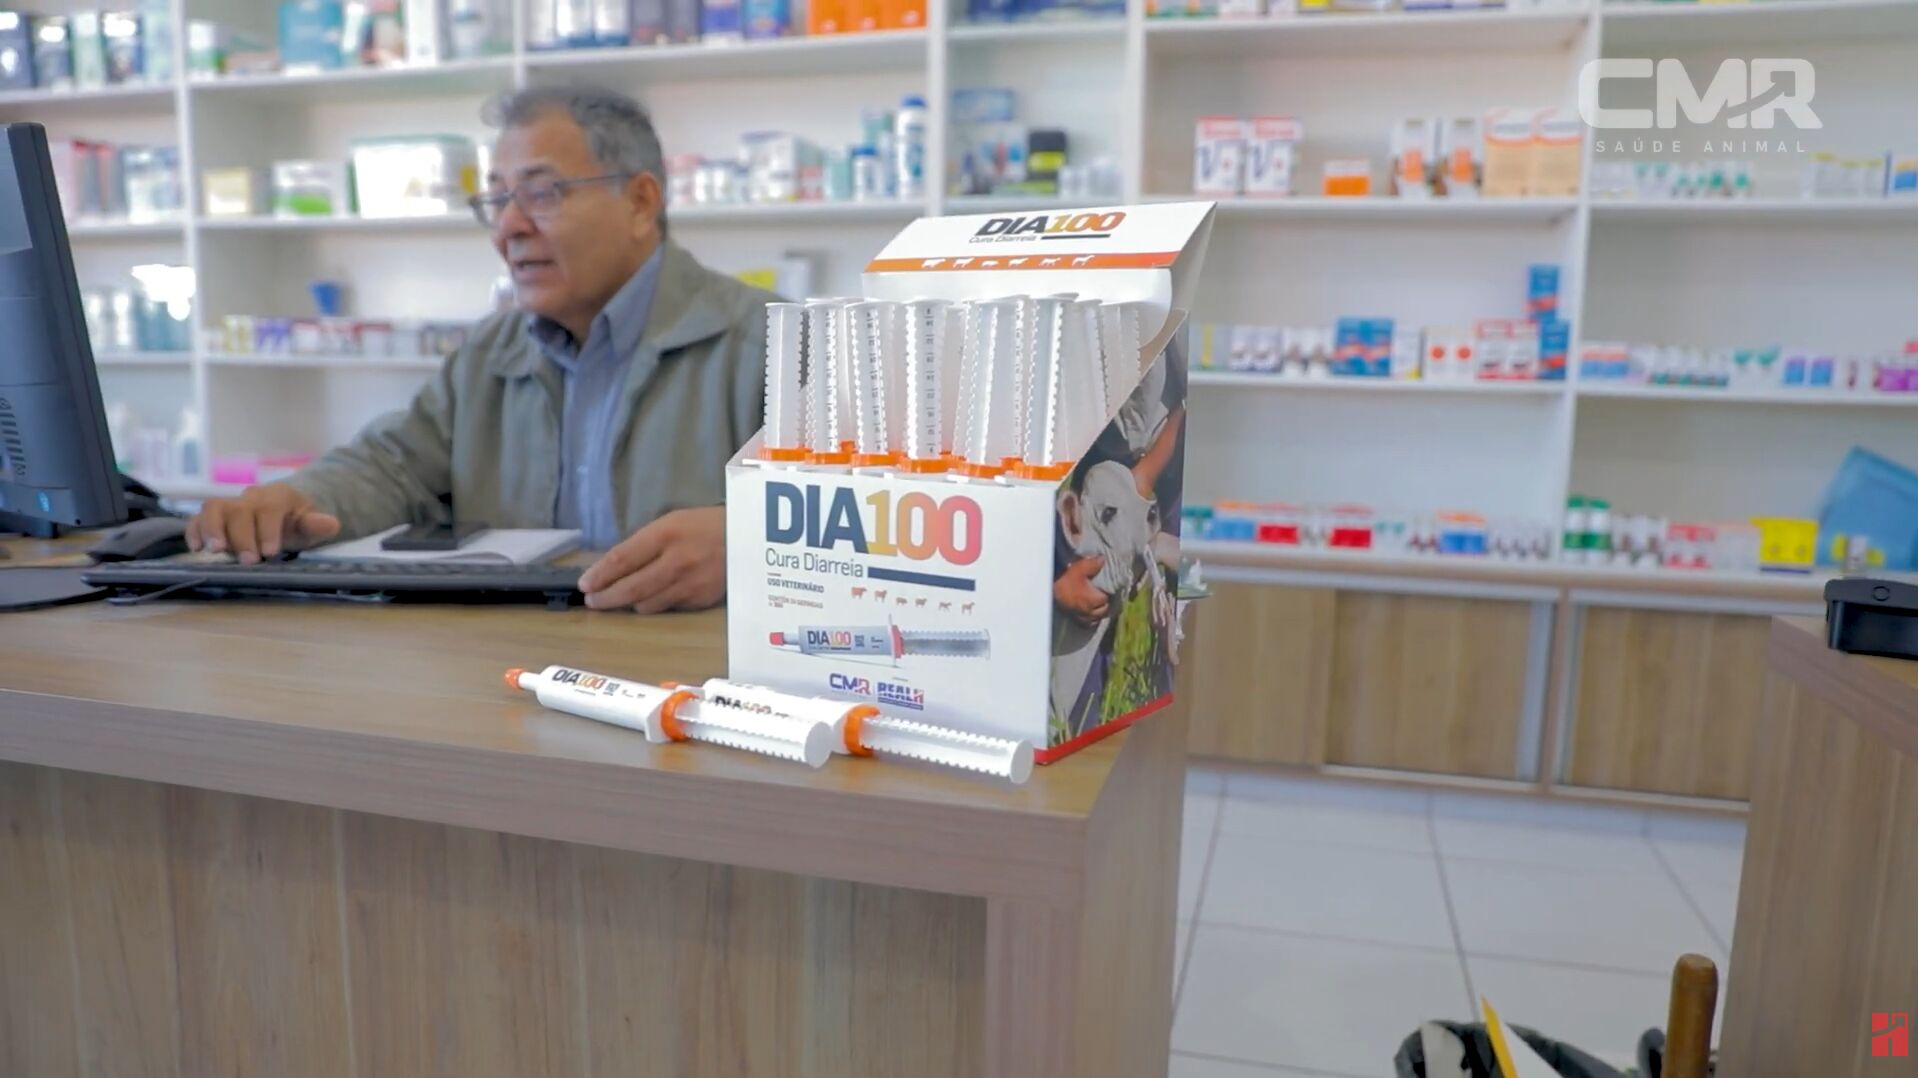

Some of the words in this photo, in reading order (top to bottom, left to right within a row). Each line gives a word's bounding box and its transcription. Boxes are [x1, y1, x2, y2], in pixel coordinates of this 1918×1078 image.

[975, 211, 1127, 236] DIA100
[969, 236, 994, 244] Cura
[765, 481, 983, 566] DIA100
[766, 548, 800, 570] Cura
[803, 552, 864, 578] Diarreia
[767, 577, 780, 587] USO
[781, 579, 825, 593] VETERINÁRIO
[808, 630, 852, 646] DIA100
[552, 668, 607, 690] DIA100
[829, 673, 871, 696] CMR
